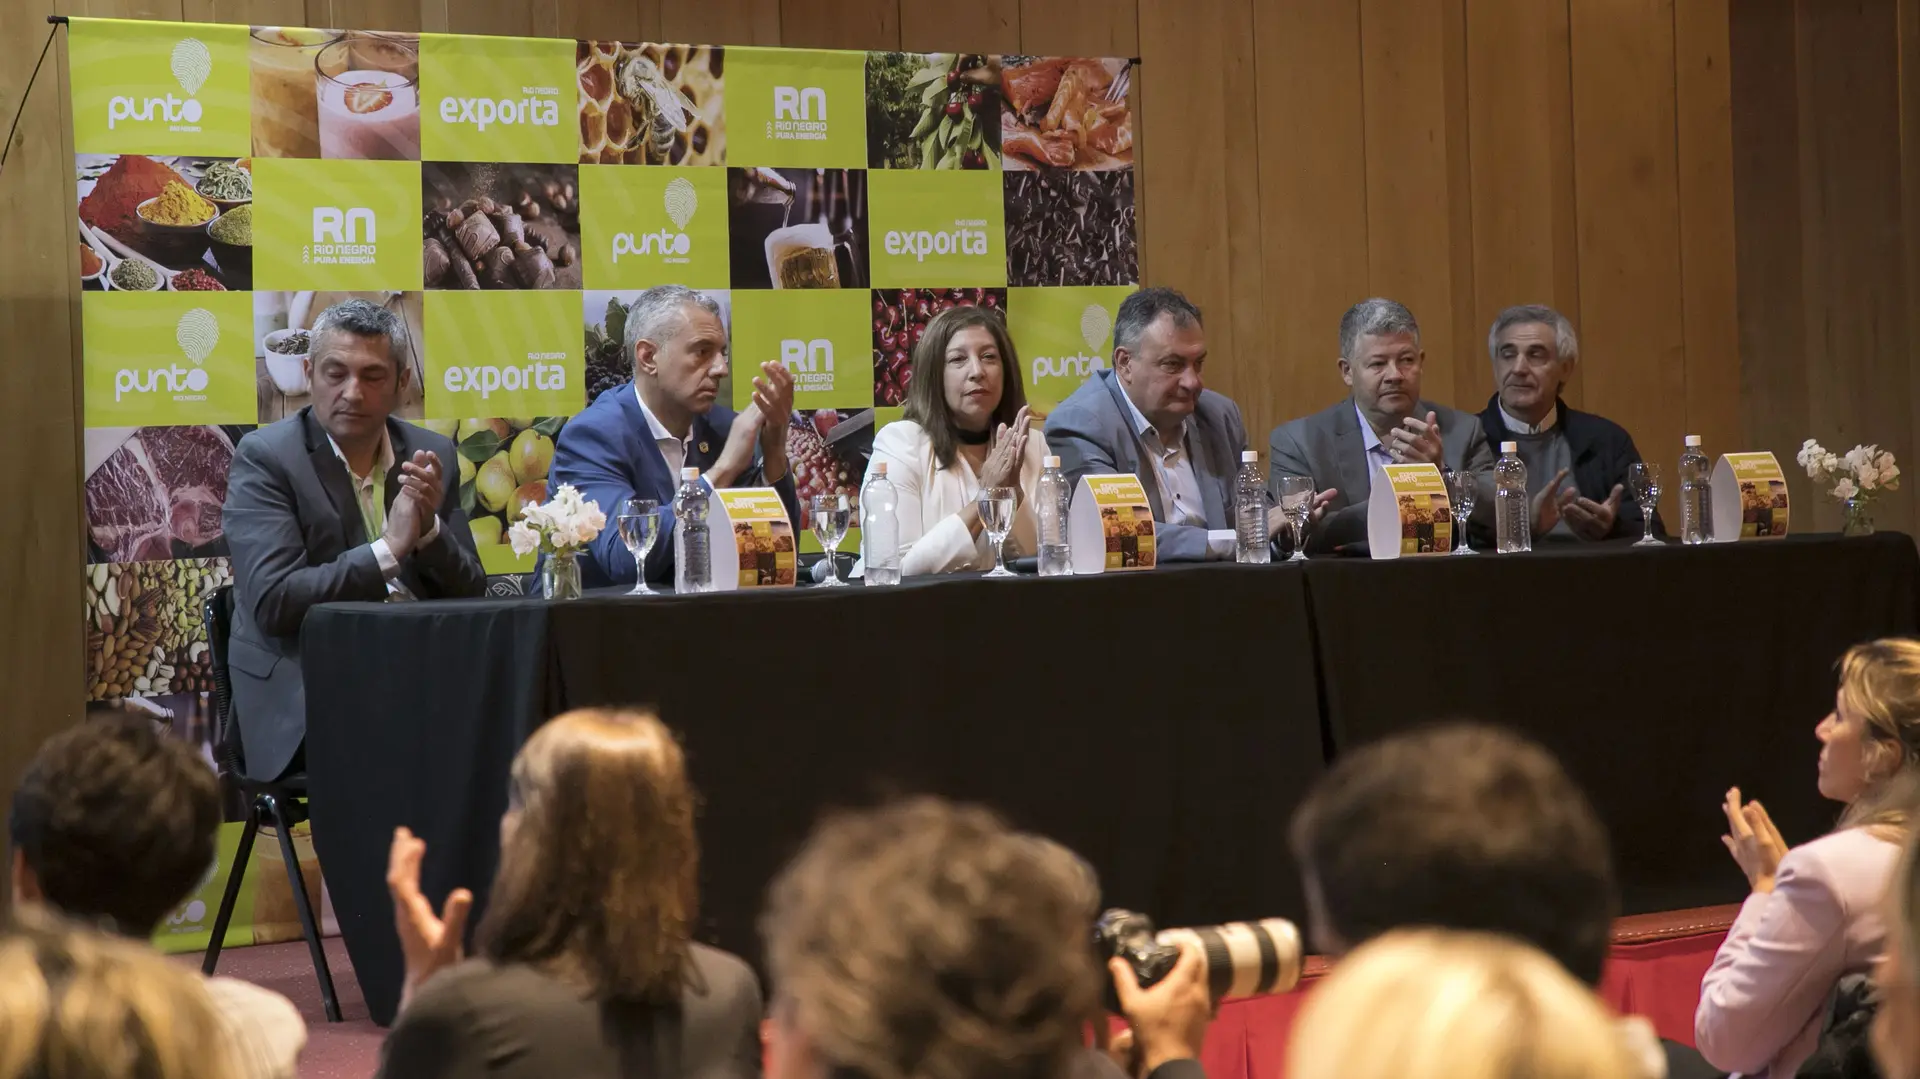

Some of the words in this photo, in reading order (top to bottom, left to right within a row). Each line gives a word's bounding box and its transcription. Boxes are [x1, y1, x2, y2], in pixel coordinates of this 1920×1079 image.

[108, 92, 202, 130] punto
[439, 96, 559, 132] exporta
[774, 86, 827, 120] RN
[793, 121, 827, 132] NEGRO
[313, 206, 376, 243] RN
[313, 256, 337, 265] PURA
[335, 244, 376, 255] NEGRO
[612, 227, 691, 264] punto
[884, 229, 988, 262] exporta
[115, 363, 208, 402] punto
[444, 362, 566, 399] exporta
[800, 373, 834, 382] NEGRO
